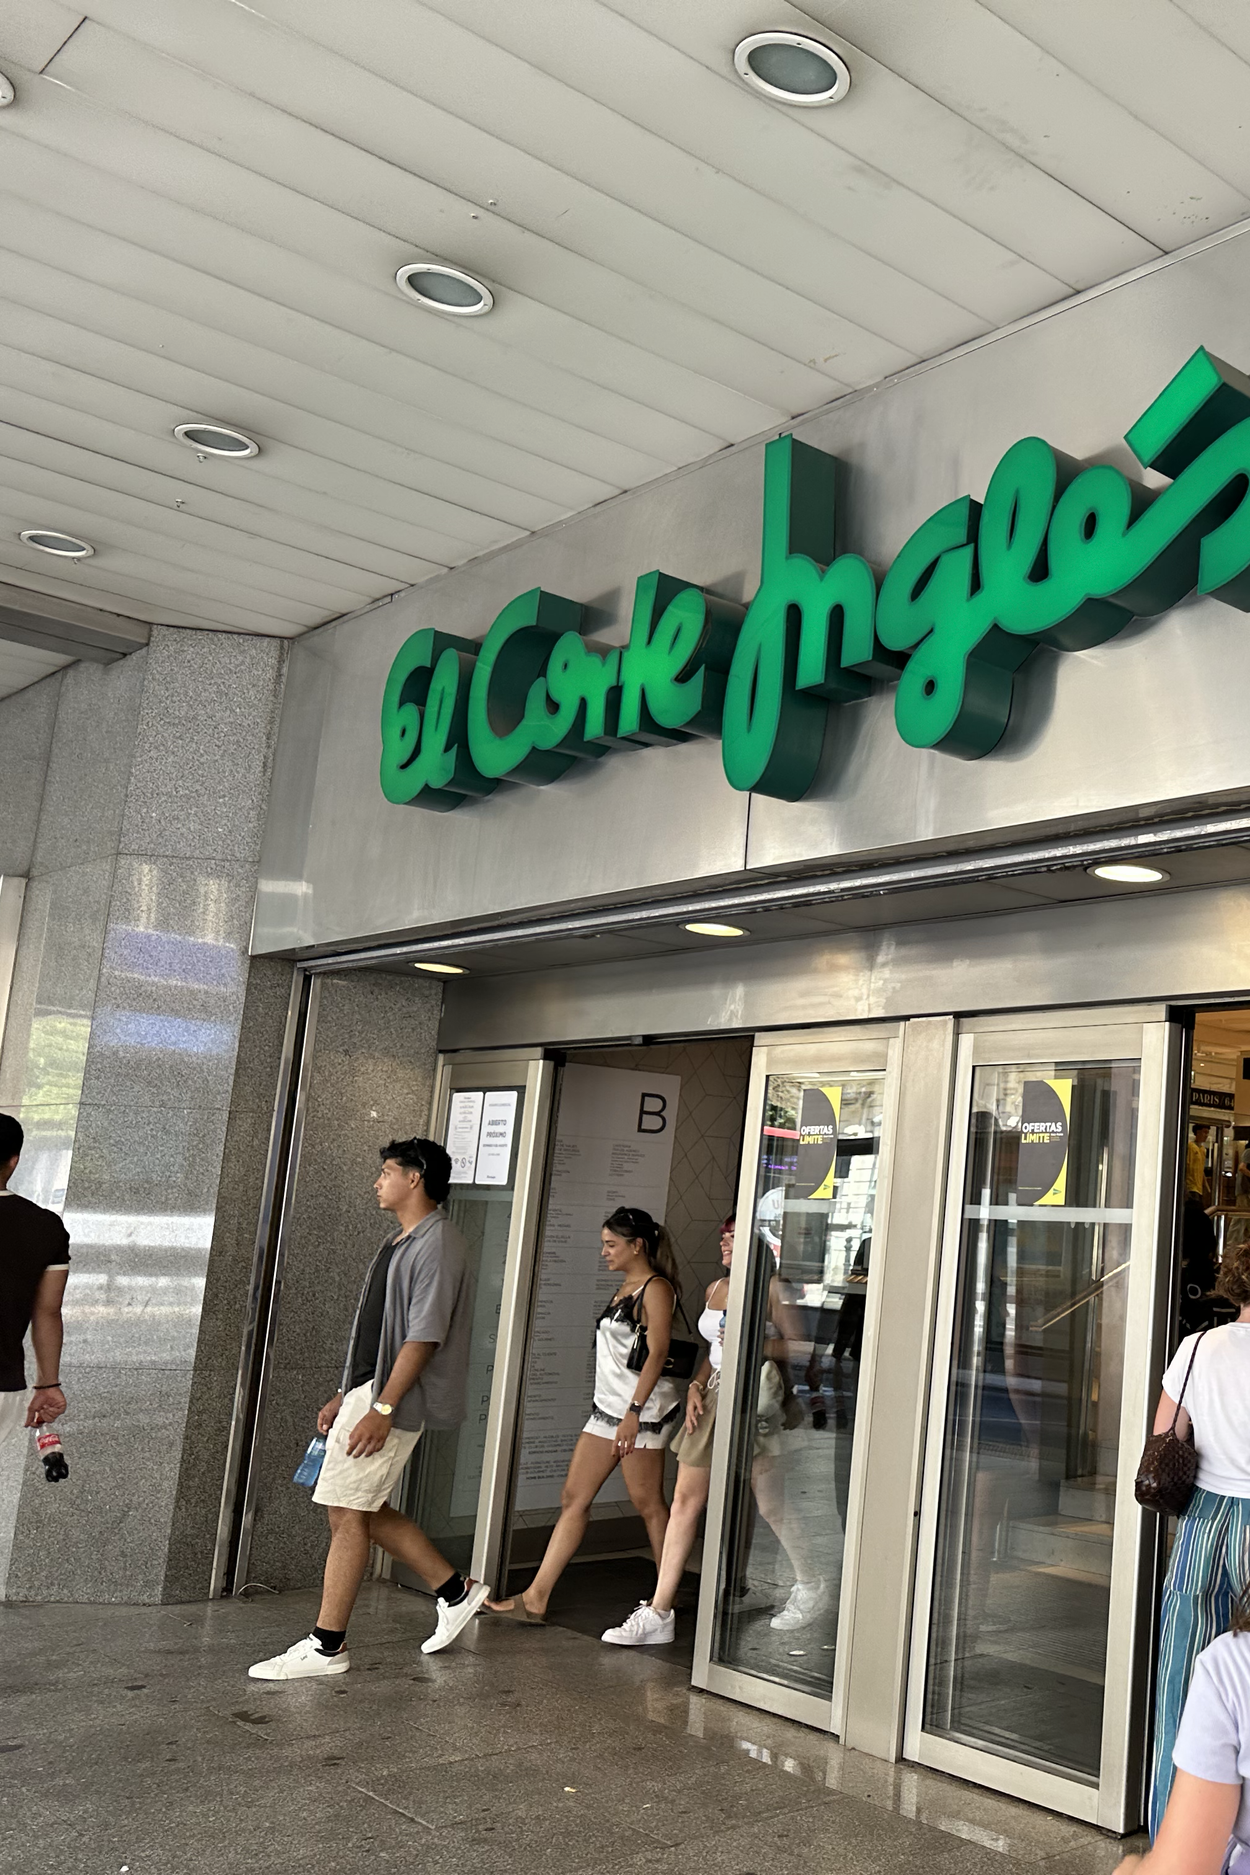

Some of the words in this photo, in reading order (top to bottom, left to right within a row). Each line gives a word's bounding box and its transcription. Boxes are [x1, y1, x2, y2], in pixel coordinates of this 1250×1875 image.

[380, 627, 460, 805] El
[467, 568, 711, 779] Corte
[636, 1092, 667, 1134] B
[800, 1125, 834, 1135] OFERTAS
[1022, 1122, 1063, 1133] OFERTAS
